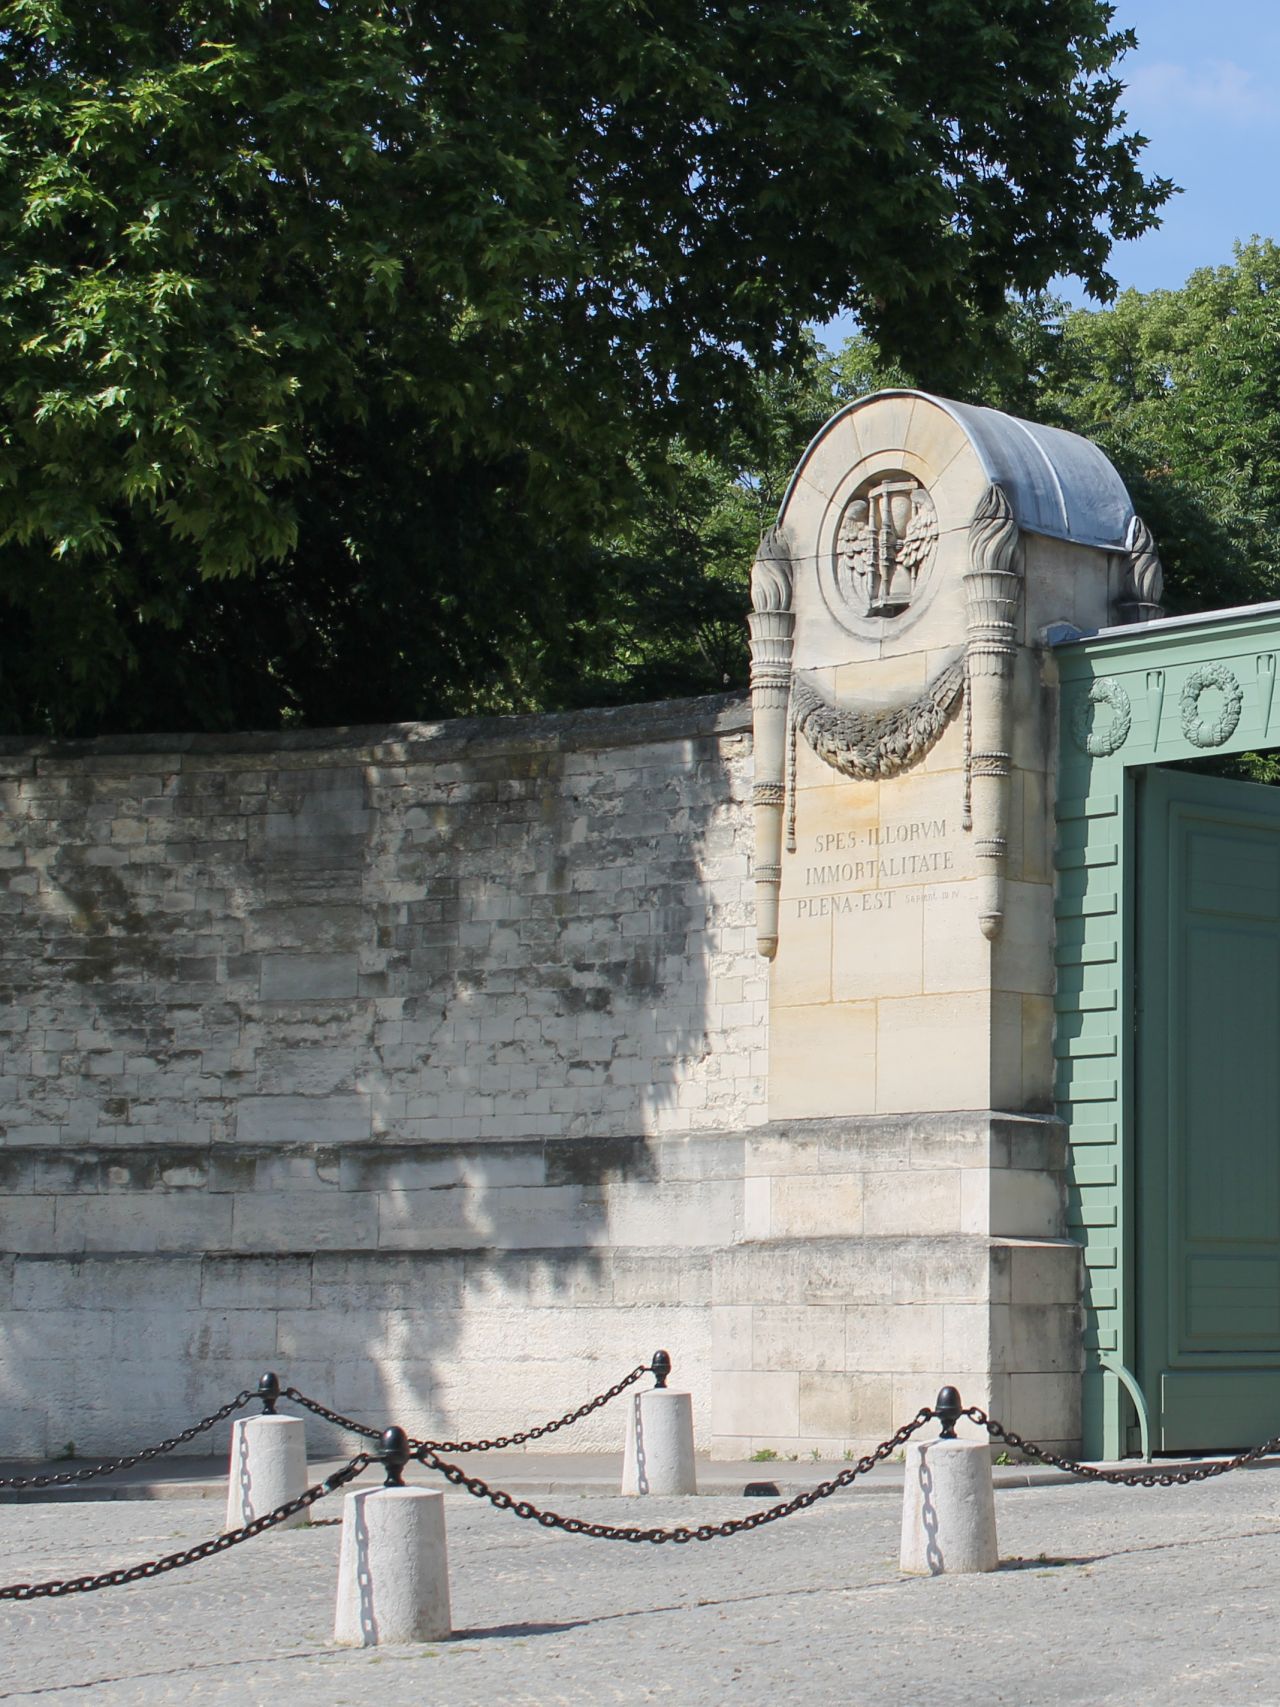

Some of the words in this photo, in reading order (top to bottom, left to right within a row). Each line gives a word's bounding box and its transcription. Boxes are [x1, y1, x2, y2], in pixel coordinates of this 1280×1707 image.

[815, 831, 856, 853] SPES
[868, 819, 946, 846] ILLORVM
[806, 851, 954, 886] IMMORTALITATE
[797, 896, 853, 918] PLENA
[862, 891, 896, 911] EST
